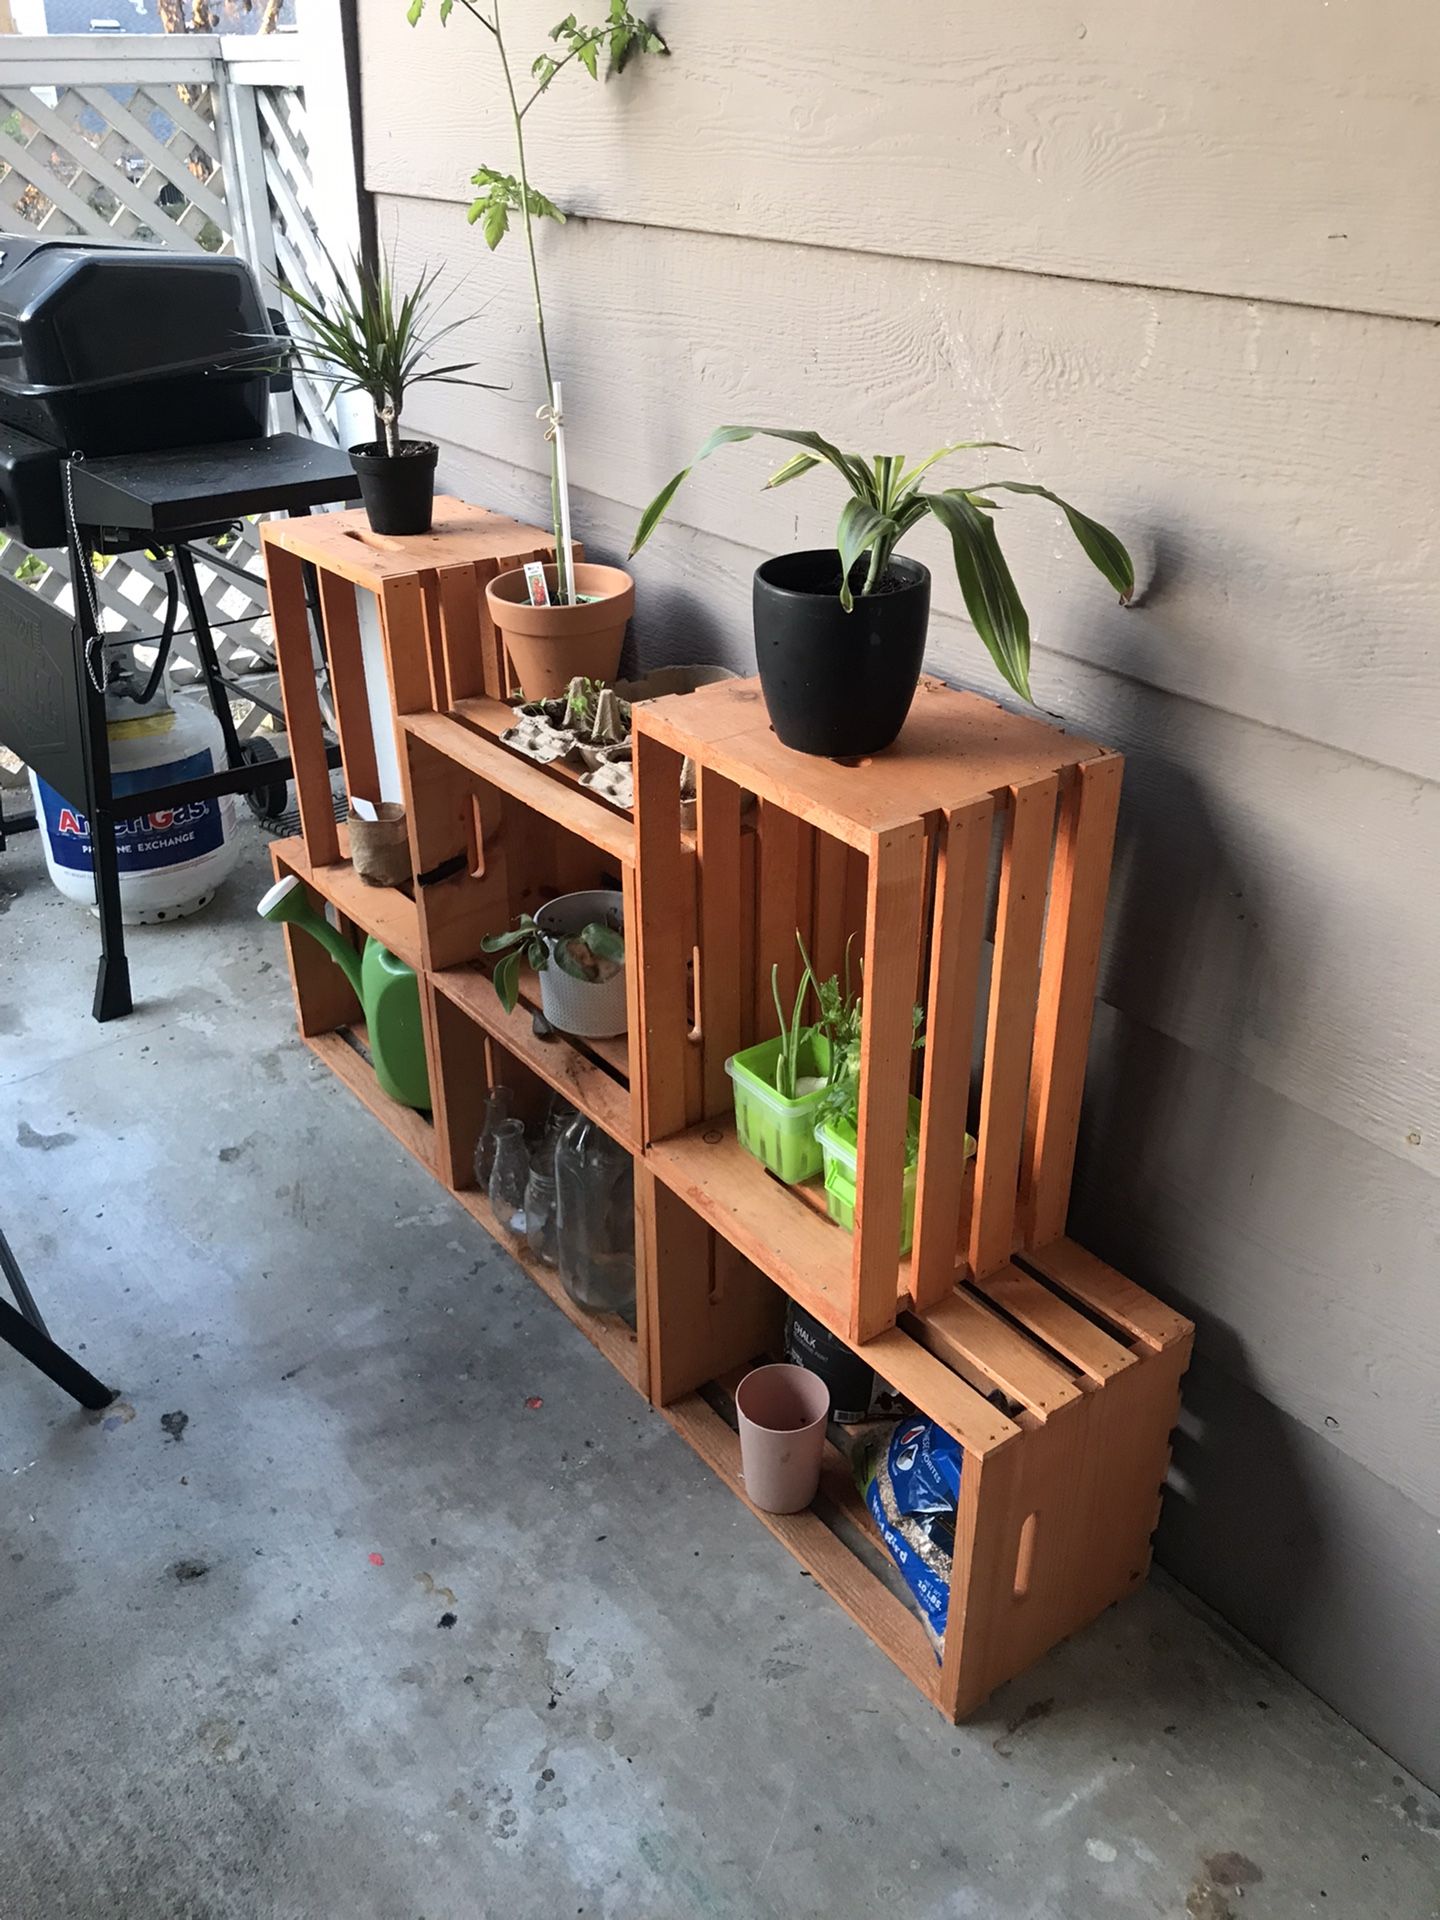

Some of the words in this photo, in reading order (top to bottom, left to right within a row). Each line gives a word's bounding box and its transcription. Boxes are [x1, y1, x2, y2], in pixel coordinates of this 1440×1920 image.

[138, 831, 195, 853] EXCHANGE
[793, 1320, 817, 1349] CHALK
[884, 1530, 908, 1564] Bird
